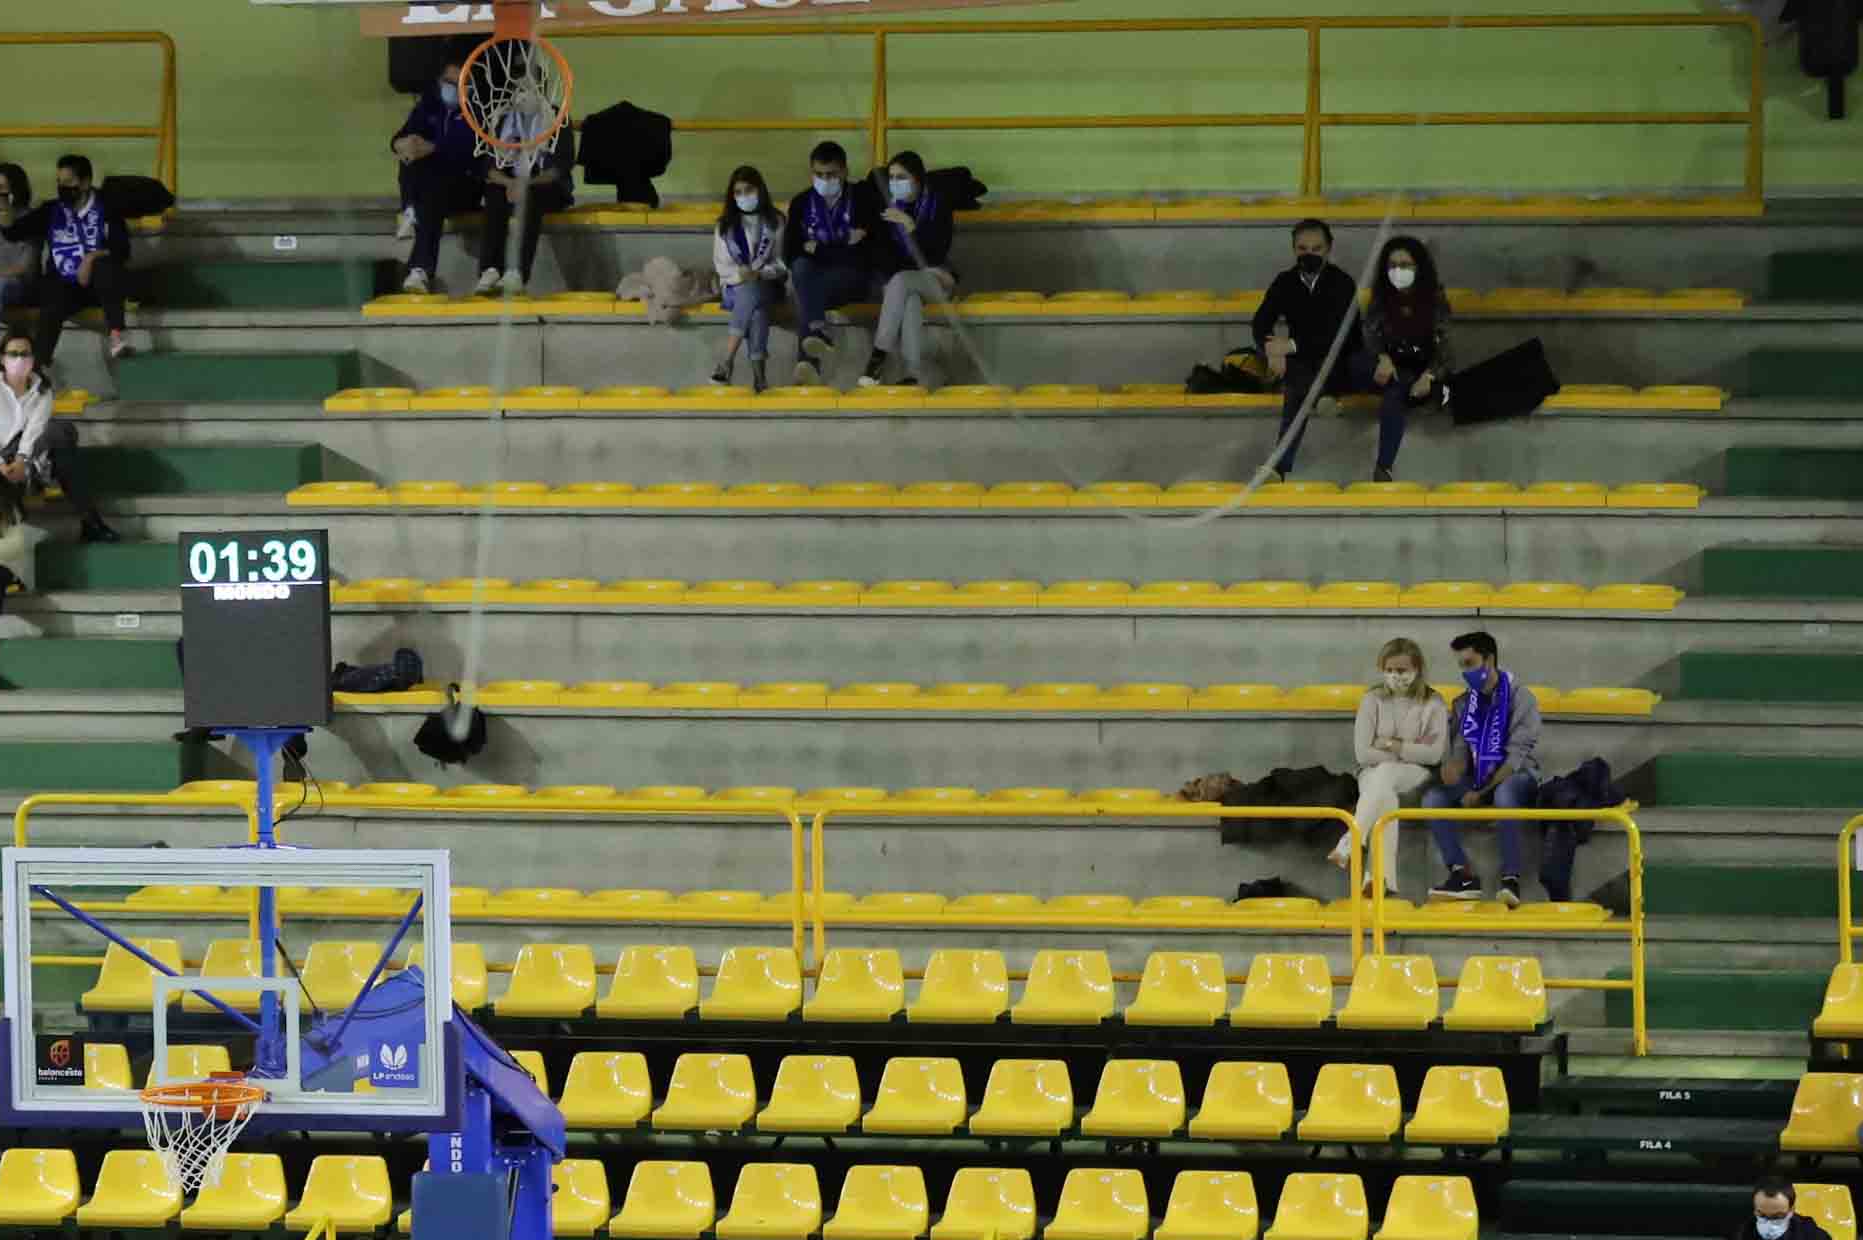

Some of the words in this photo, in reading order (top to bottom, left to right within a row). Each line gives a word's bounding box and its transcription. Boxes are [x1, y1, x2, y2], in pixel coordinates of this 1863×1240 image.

[189, 539, 317, 582] 01:39
[1659, 1091, 1682, 1100] FILA
[1639, 1140, 1663, 1150] FILA
